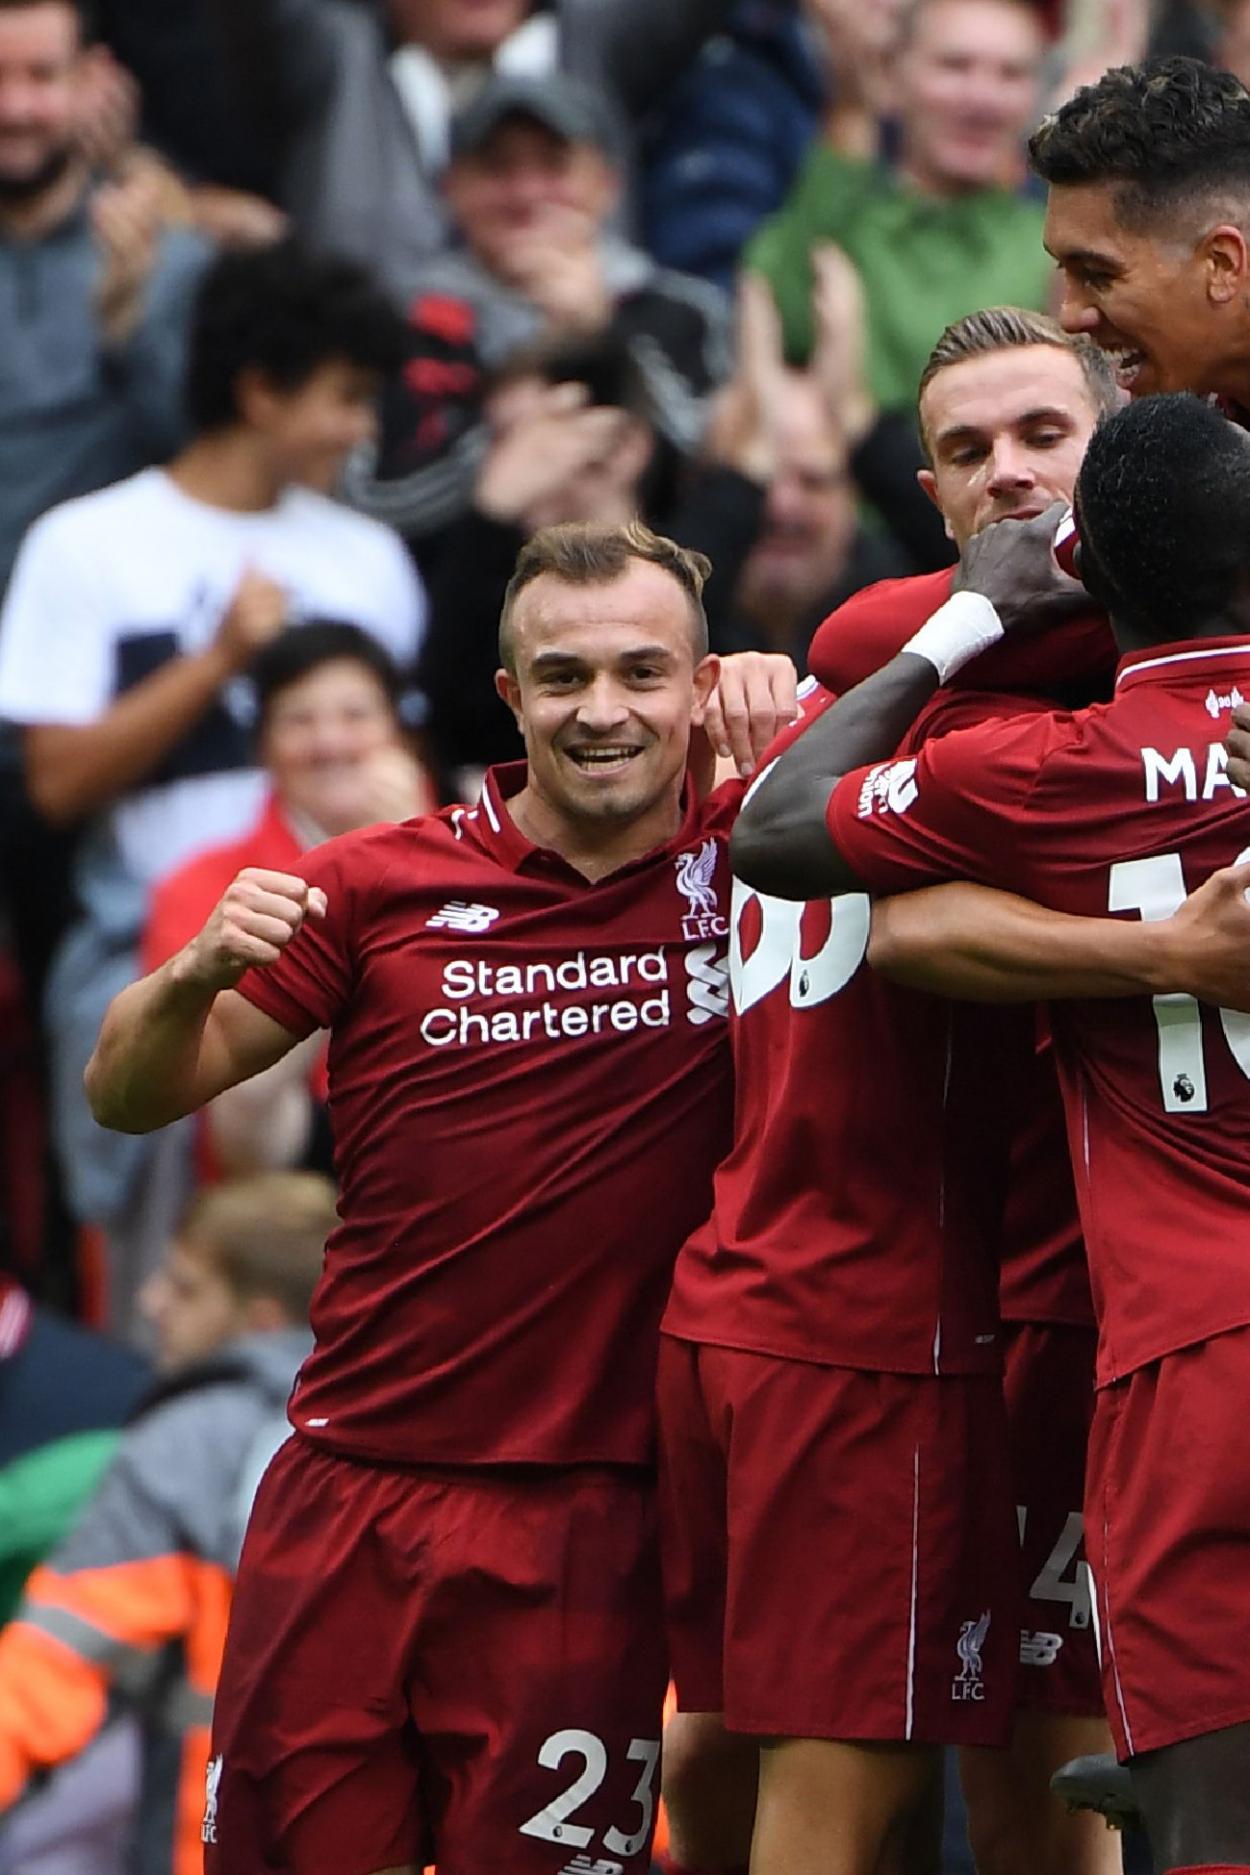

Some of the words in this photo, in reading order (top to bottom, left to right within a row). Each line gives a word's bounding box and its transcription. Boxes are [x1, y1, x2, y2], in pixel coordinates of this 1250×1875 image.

[1140, 742, 1248, 803] MA
[441, 945, 669, 1000] Standard
[420, 990, 671, 1047] Chartered
[519, 1729, 660, 1857] 23
